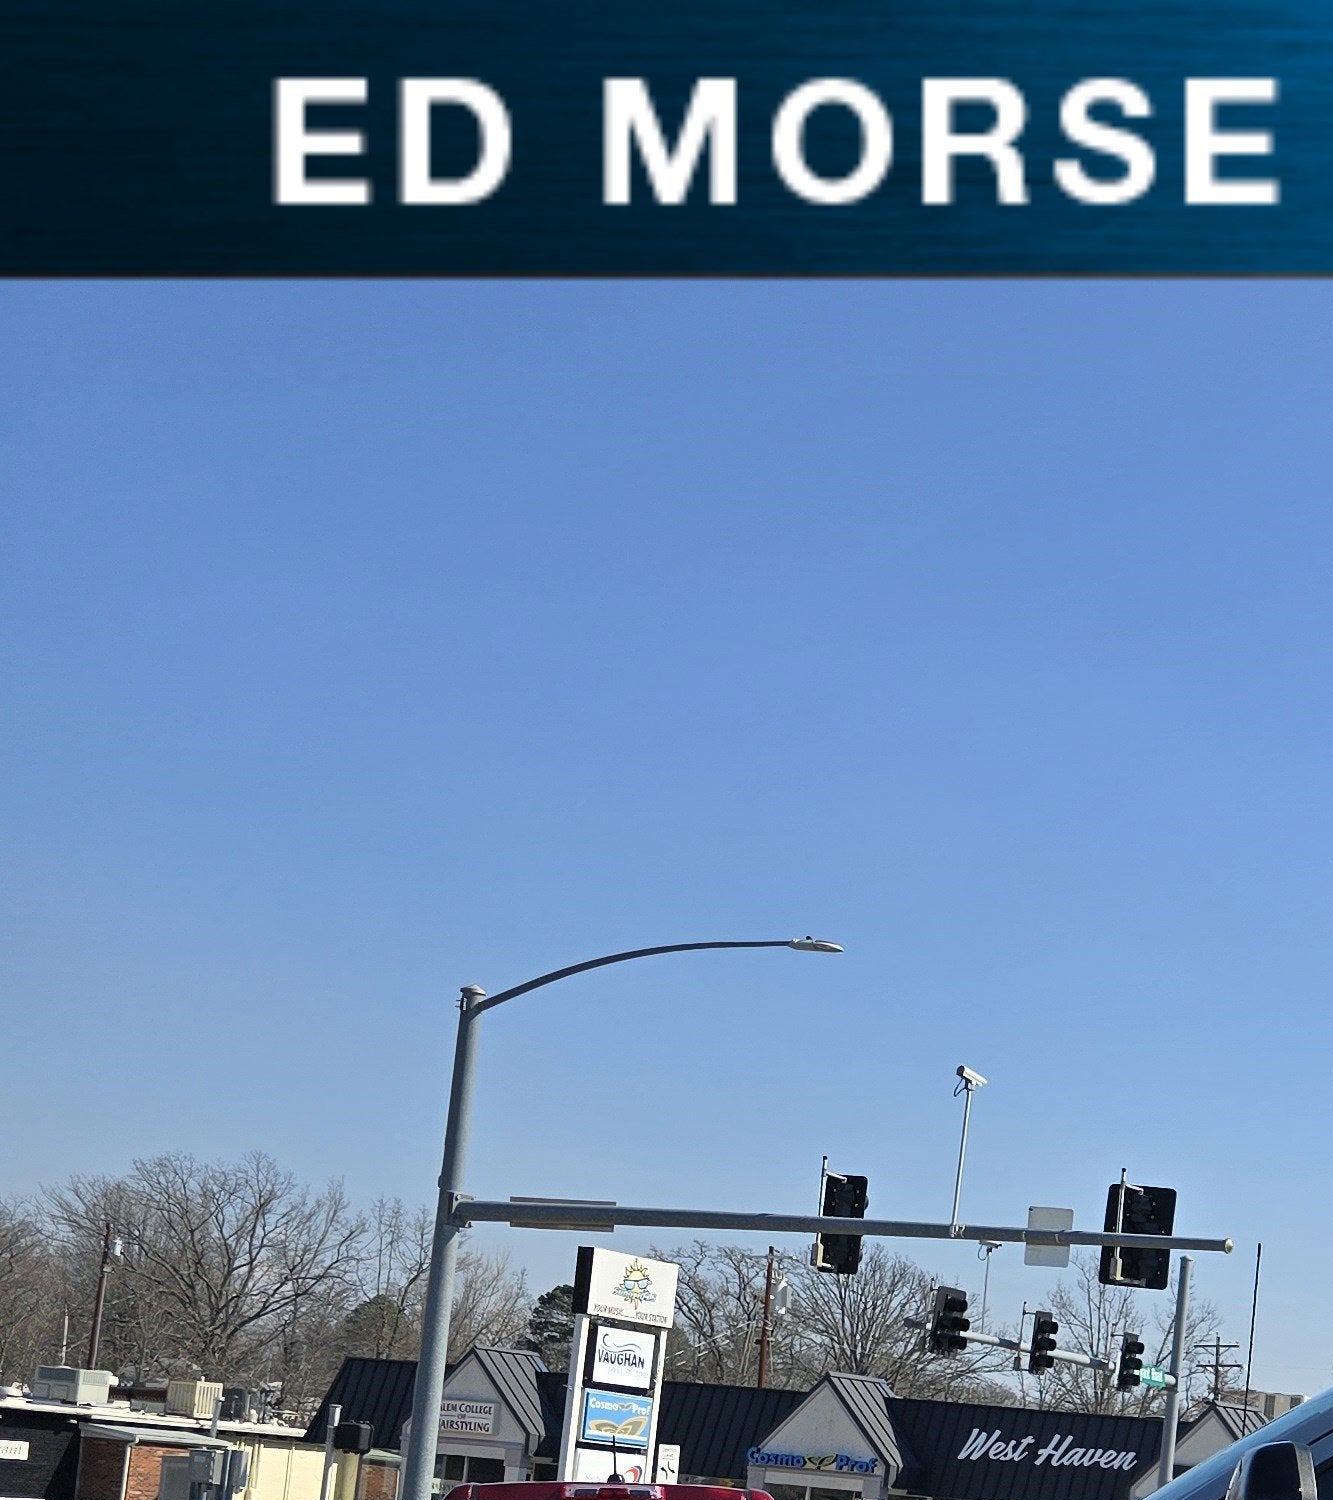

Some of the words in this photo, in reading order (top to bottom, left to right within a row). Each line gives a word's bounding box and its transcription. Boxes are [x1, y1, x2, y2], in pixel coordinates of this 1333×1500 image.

[598, 1349, 645, 1369] VAUGHAN
[459, 1403, 492, 1414] COLLEGE
[589, 1398, 619, 1411] Cosmo
[632, 1403, 651, 1416] Prof
[440, 1420, 490, 1432] AIRSTYLING
[957, 1428, 1035, 1462] West
[1034, 1433, 1138, 1471] Haven
[746, 1446, 806, 1467] Cosmo
[835, 1453, 878, 1474] Prof
